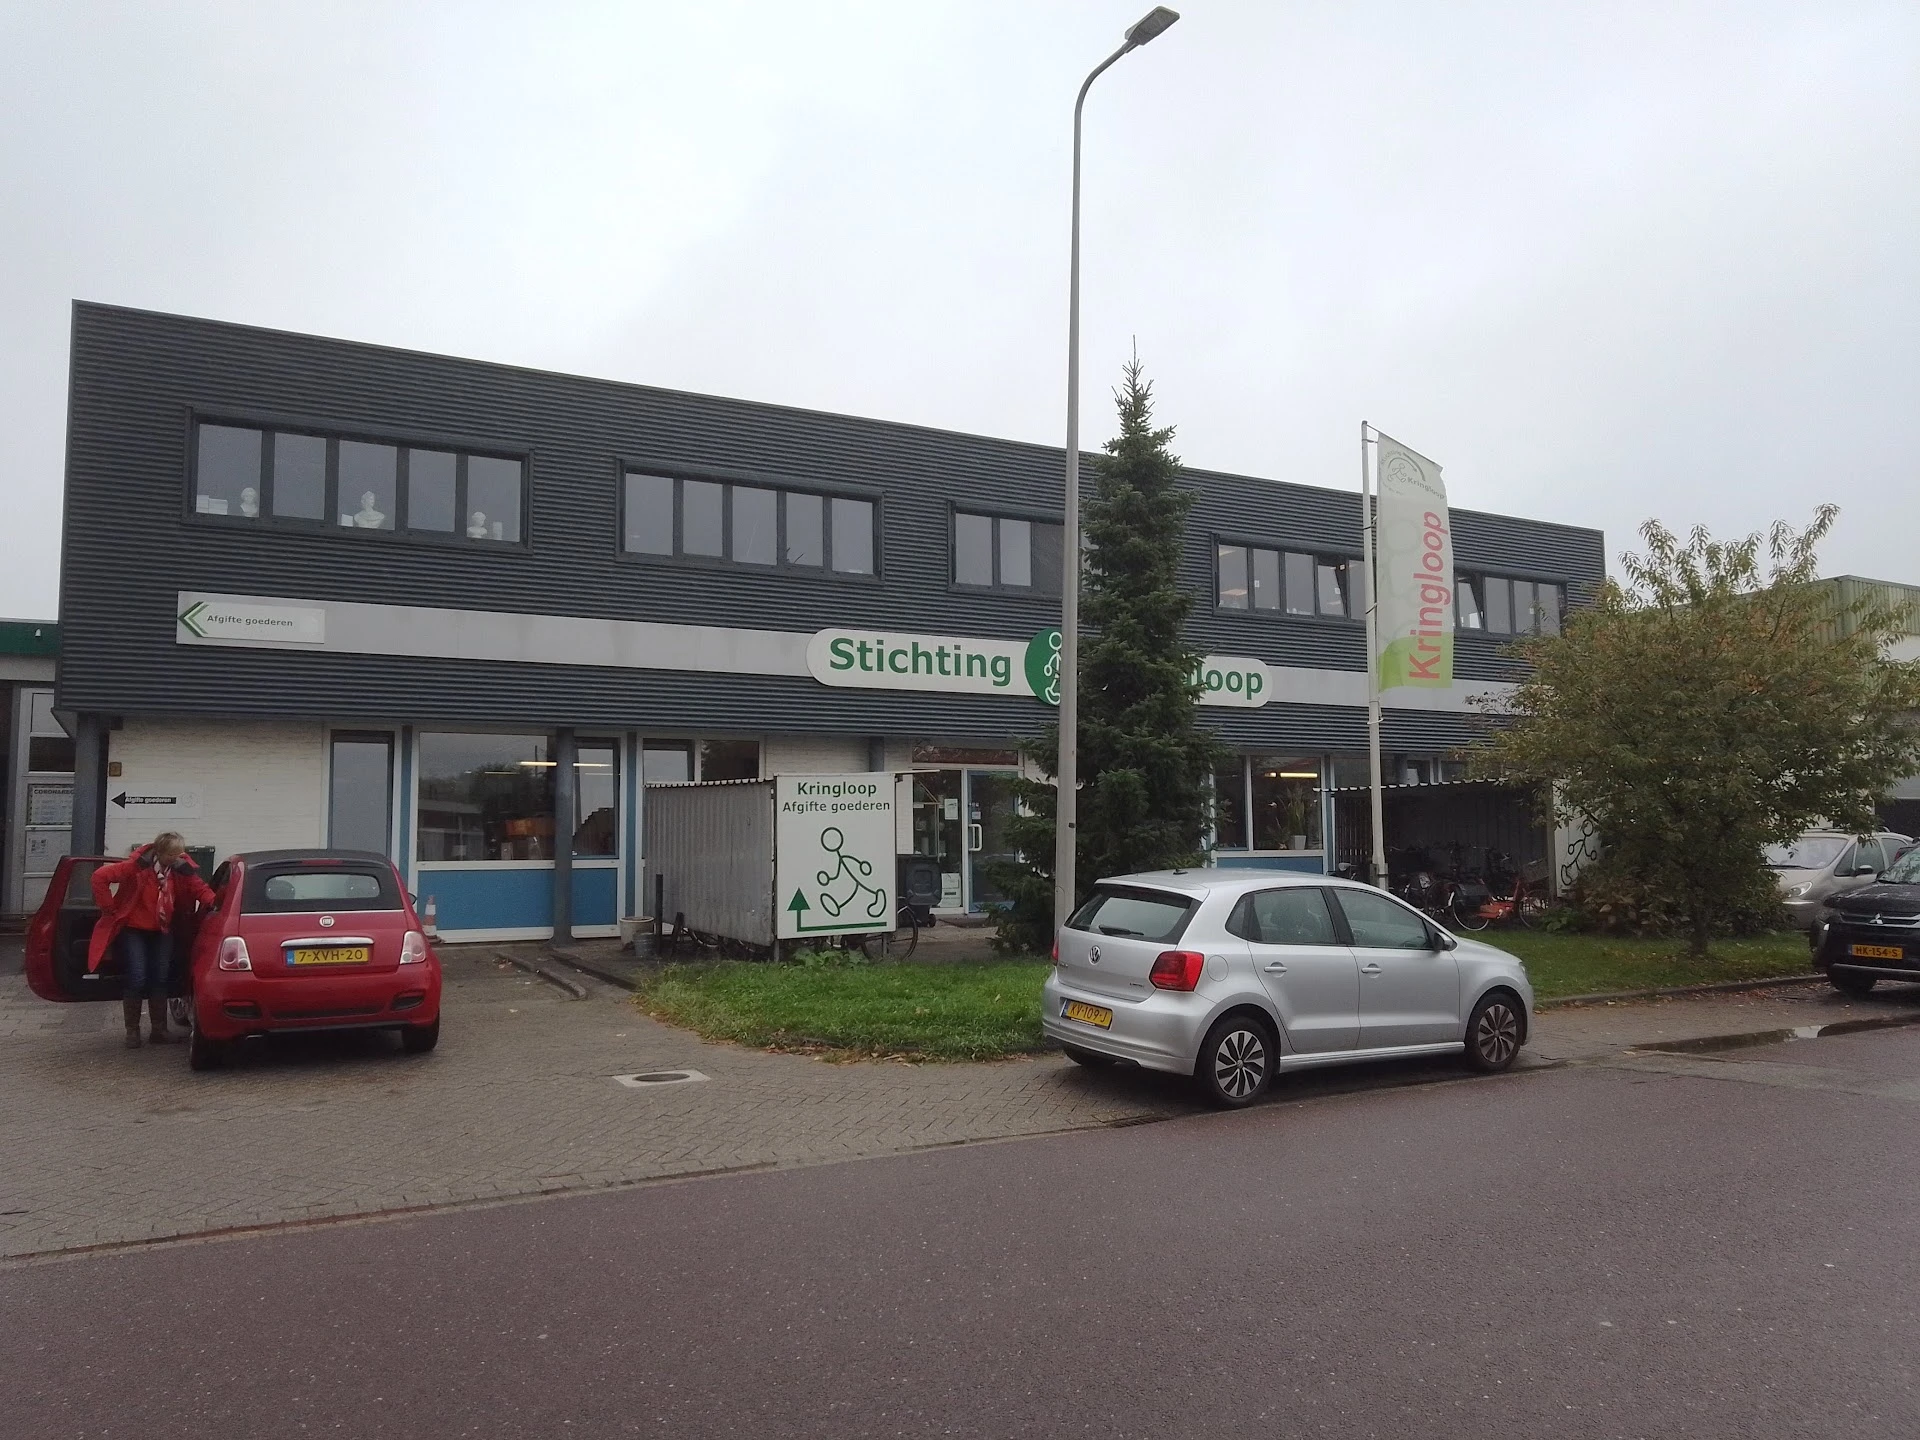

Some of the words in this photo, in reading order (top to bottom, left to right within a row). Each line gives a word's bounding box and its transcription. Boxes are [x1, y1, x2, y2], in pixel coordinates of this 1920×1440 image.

[1409, 511, 1451, 679] Kringloop
[207, 614, 242, 624] Afgifte
[245, 618, 293, 627] goederen
[829, 637, 1011, 687] Stichting
[797, 781, 877, 797] Kringloop
[782, 801, 827, 814] Afgifte
[831, 801, 890, 813] goederen
[298, 949, 363, 962] 7-XVH-20
